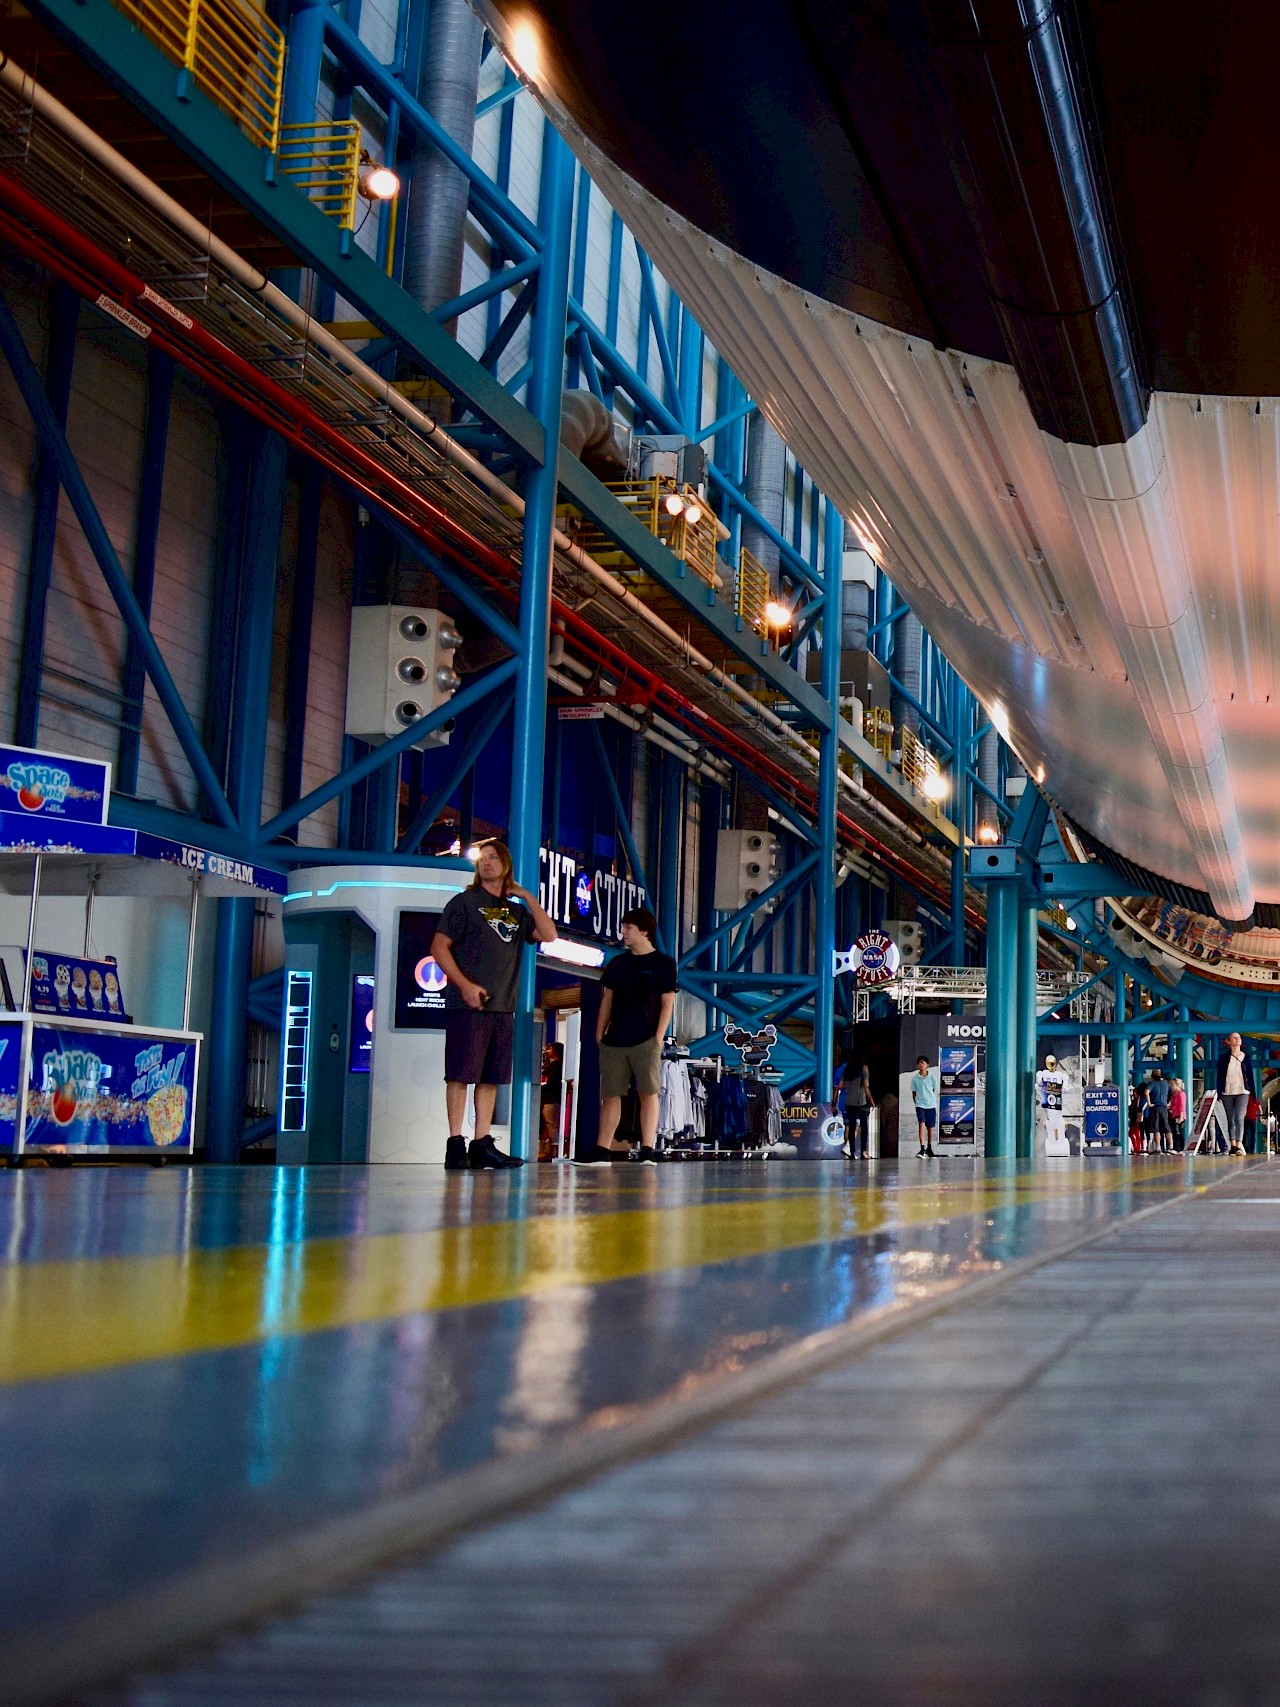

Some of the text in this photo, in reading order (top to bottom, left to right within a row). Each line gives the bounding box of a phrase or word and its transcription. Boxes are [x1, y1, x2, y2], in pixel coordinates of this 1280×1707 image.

[102, 300, 149, 335] SPRINKLER BRANCH
[8, 763, 70, 791] Space
[182, 847, 254, 884] ICE CREAM
[858, 934, 889, 949] RIGHT
[857, 967, 888, 981] STUFF
[43, 1049, 102, 1094] Space
[135, 1044, 164, 1076] TASTE
